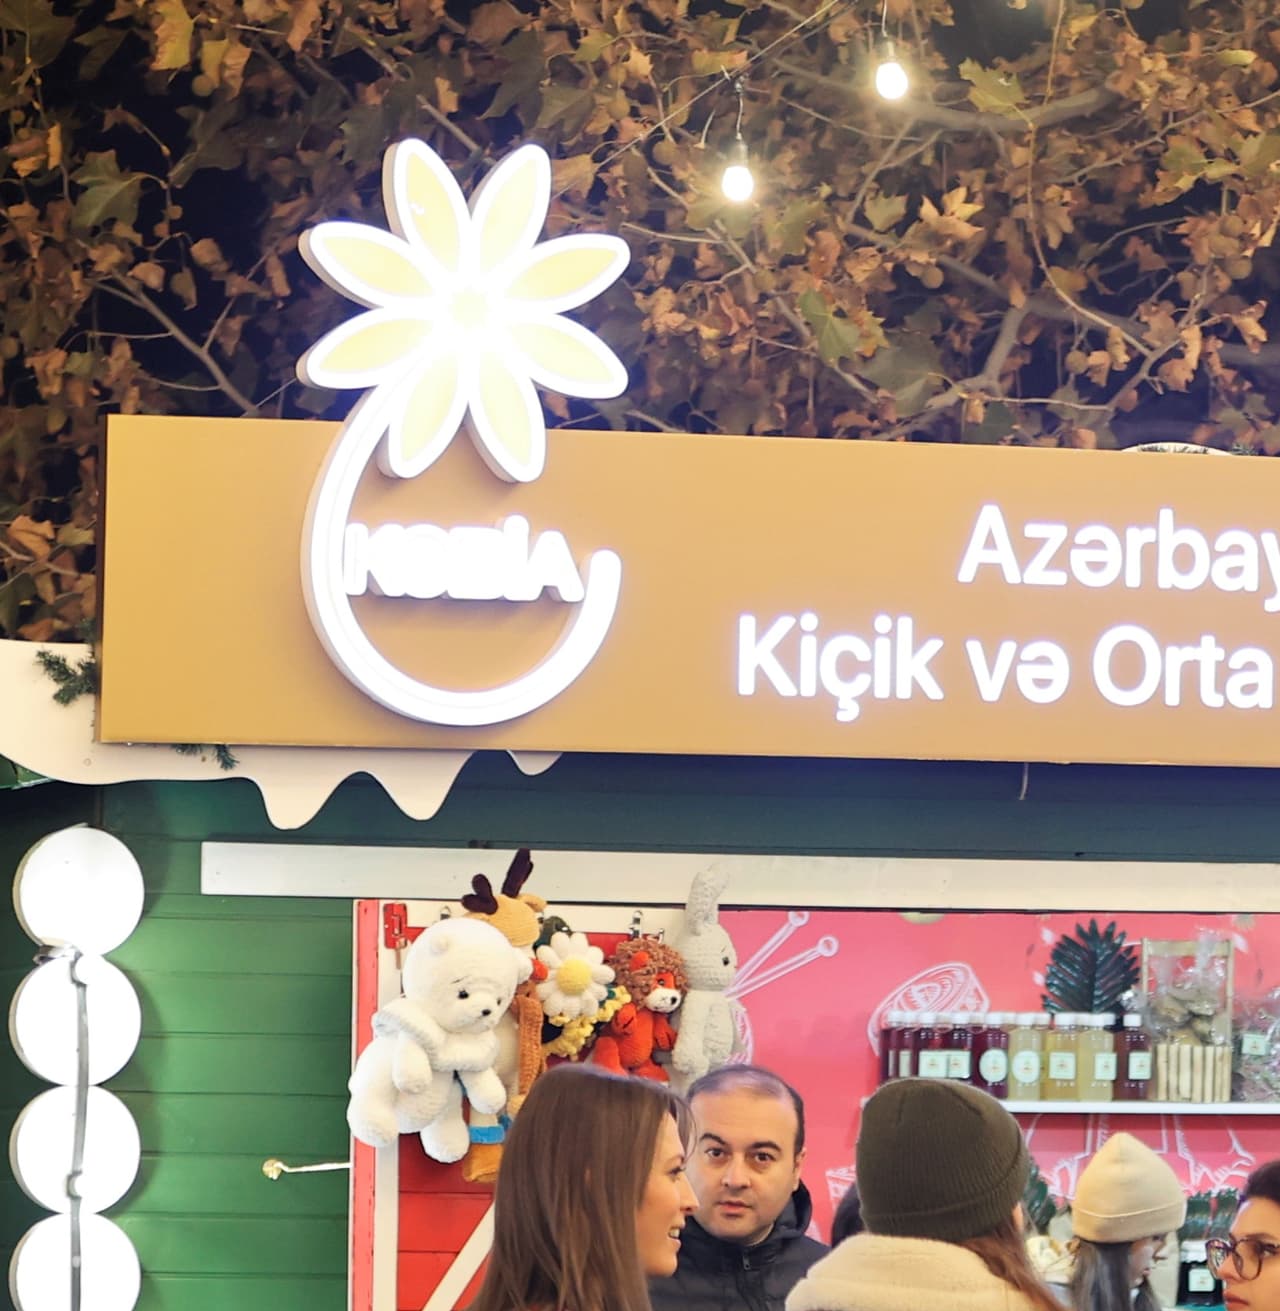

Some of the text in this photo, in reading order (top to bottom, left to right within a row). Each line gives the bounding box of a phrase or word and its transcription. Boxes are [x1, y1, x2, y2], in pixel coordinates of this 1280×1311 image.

[738, 612, 944, 722] Kiçik
[965, 639, 1070, 704] və
[1092, 624, 1274, 709] Orta
